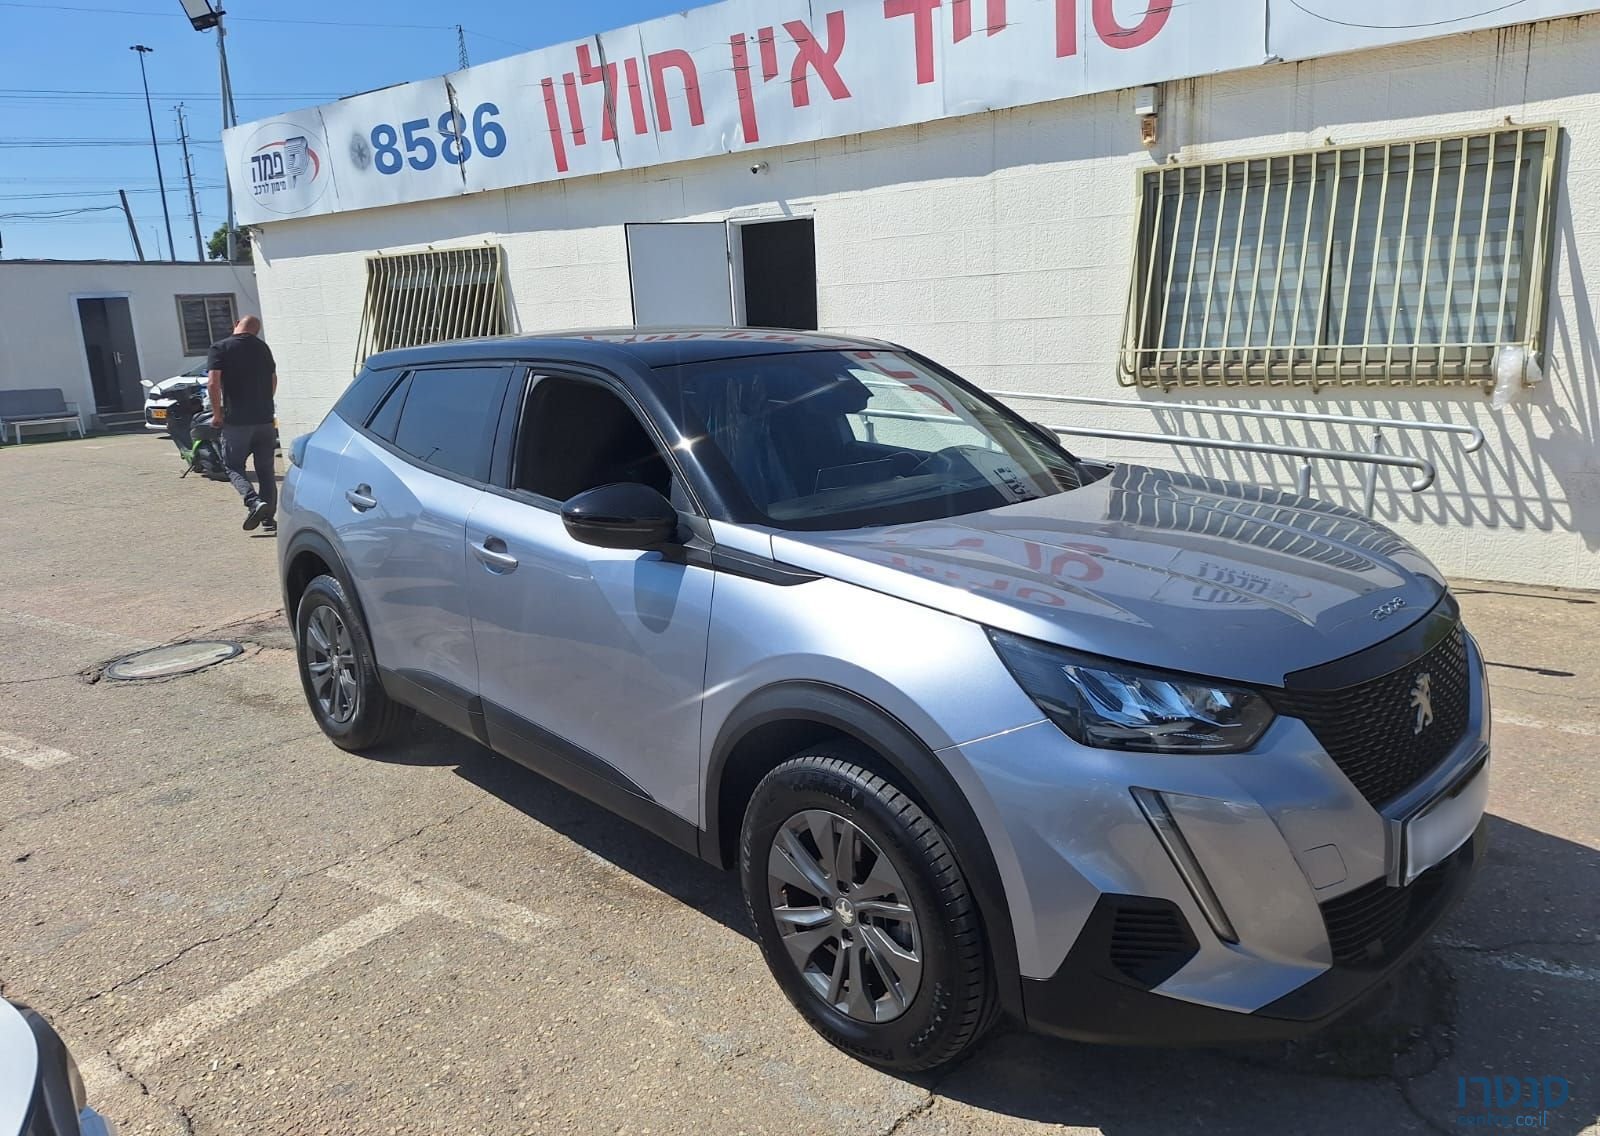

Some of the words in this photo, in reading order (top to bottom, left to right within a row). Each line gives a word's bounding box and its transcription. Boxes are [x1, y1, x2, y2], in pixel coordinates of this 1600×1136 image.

[540, 44, 705, 173] חולון
[730, 10, 853, 144] אין
[251, 151, 286, 183] פמה
